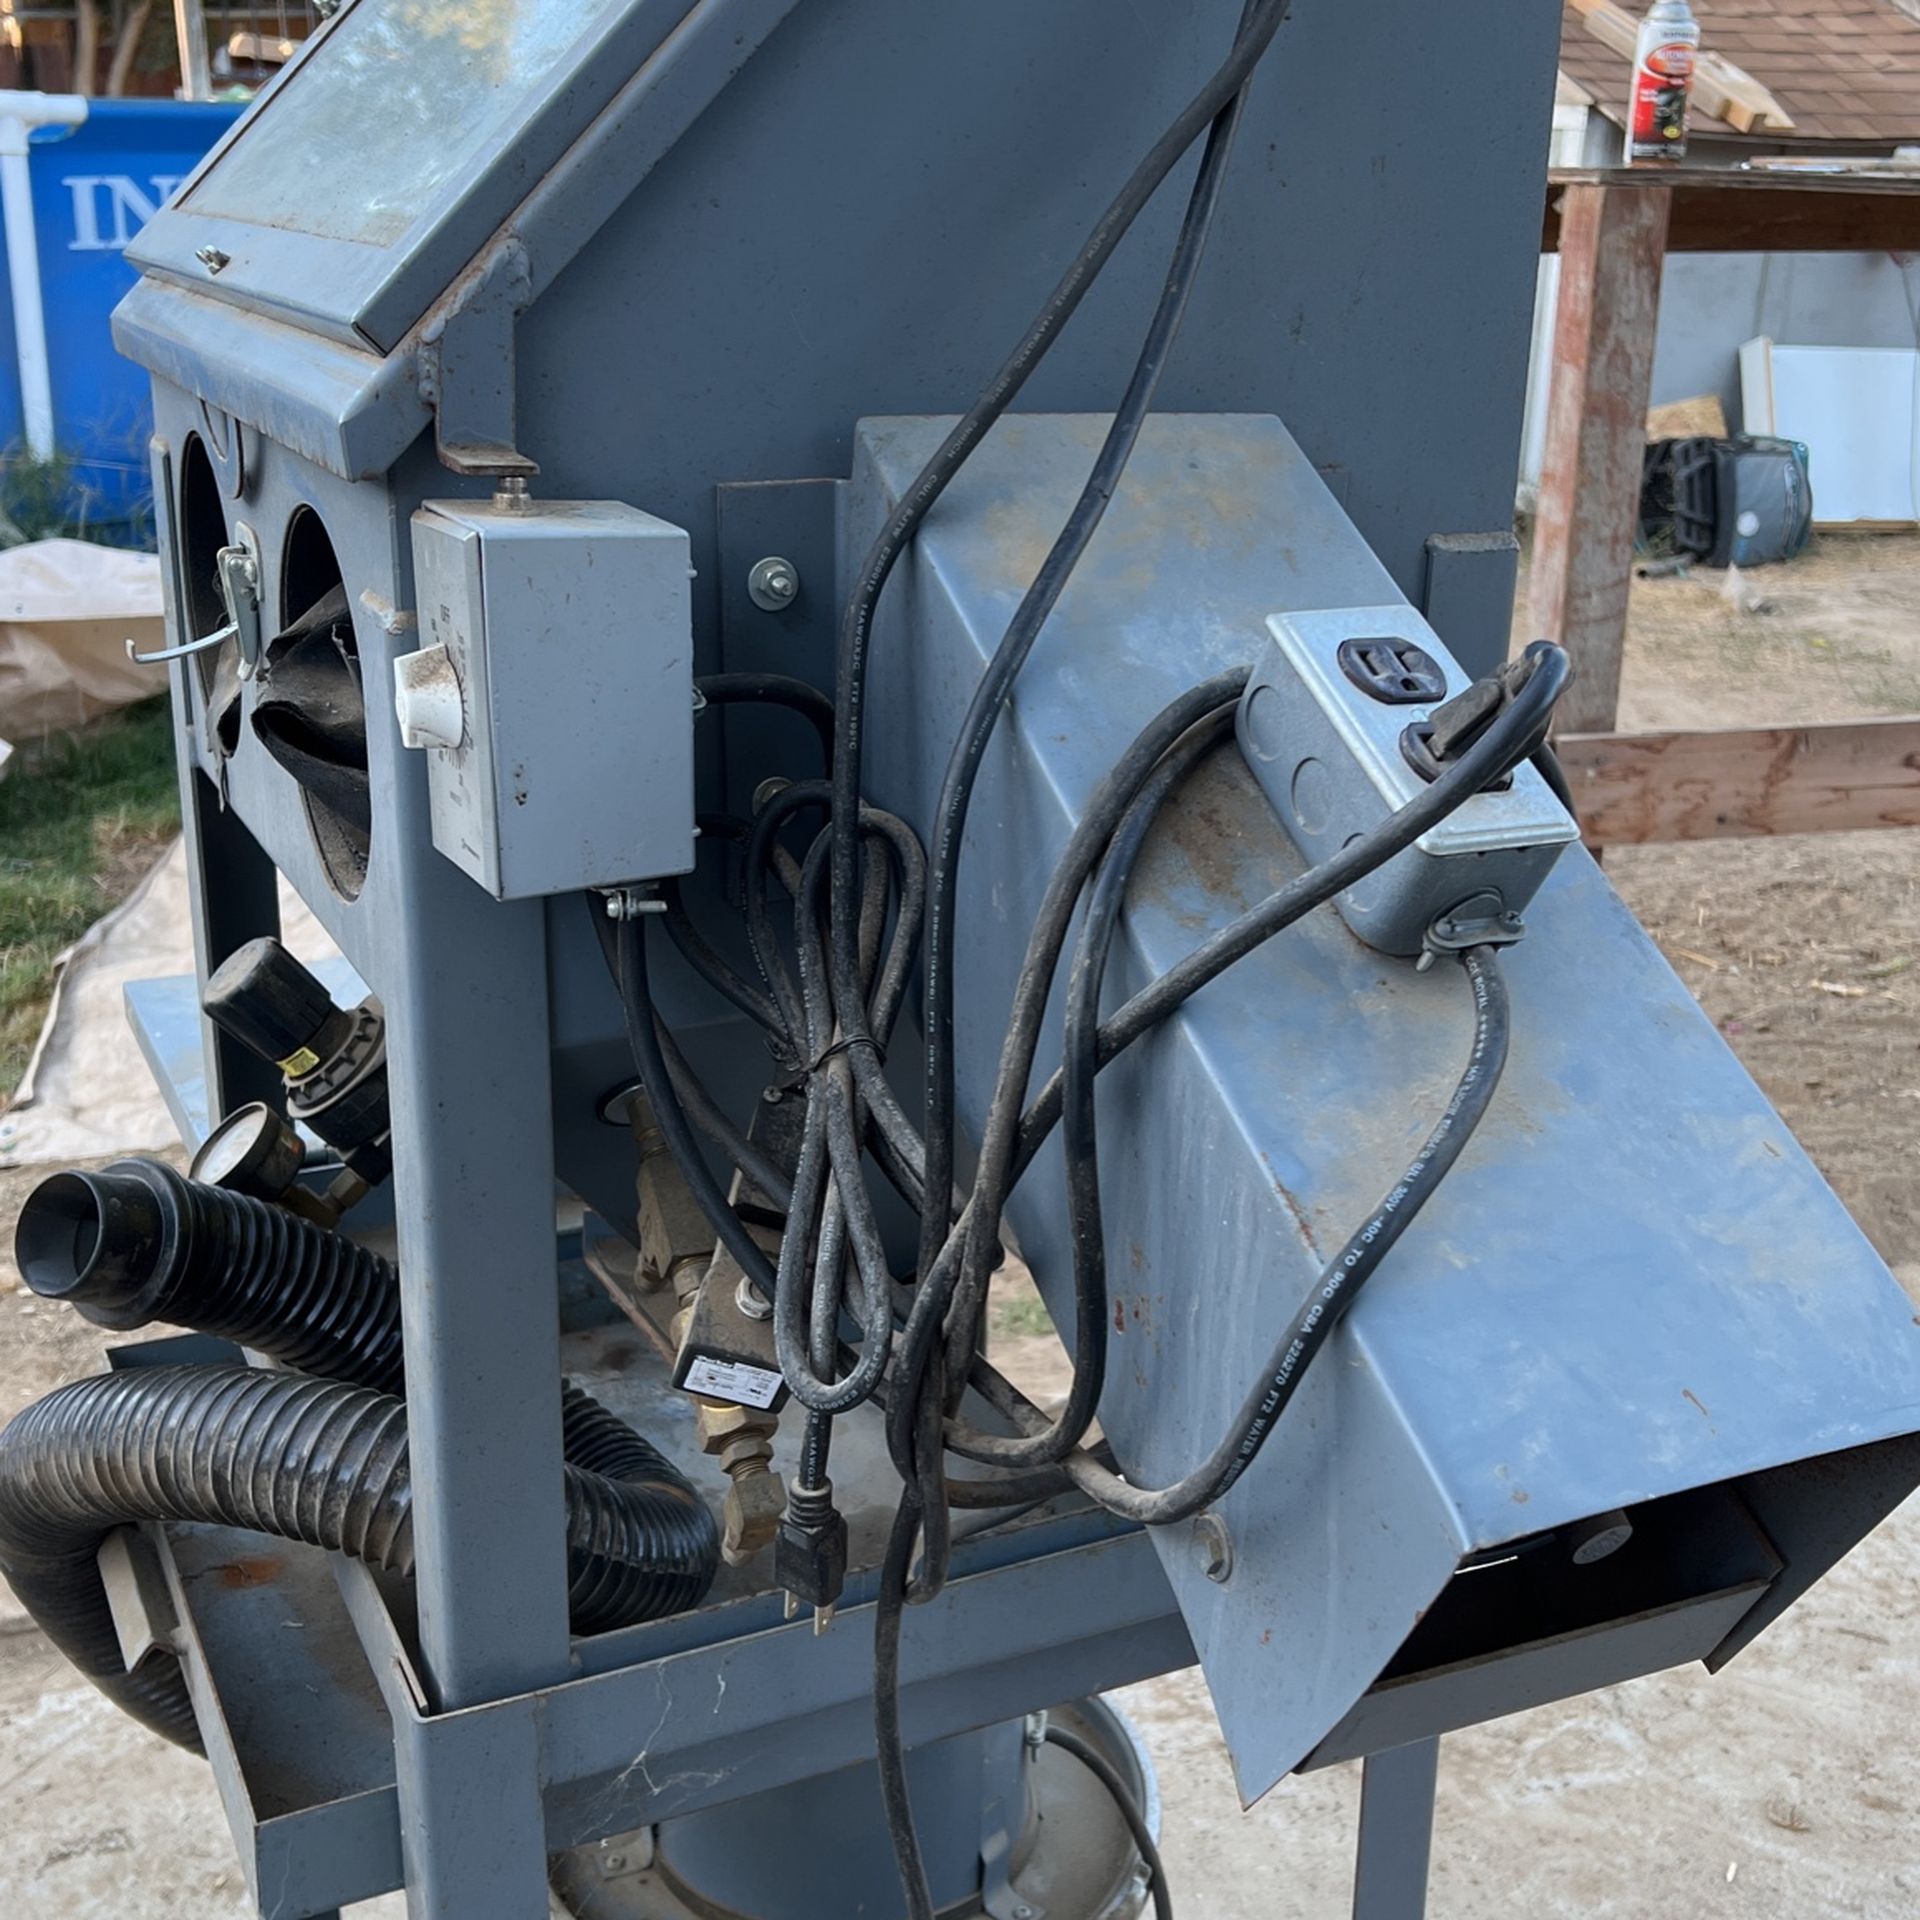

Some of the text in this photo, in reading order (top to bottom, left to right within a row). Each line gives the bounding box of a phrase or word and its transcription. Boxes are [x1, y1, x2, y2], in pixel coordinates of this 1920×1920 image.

[1474, 977, 1489, 1010] ROYAL
[1344, 1248, 1364, 1267] TO
[1300, 1304, 1324, 1334] CSA
[1240, 1418, 1267, 1456] WATER
